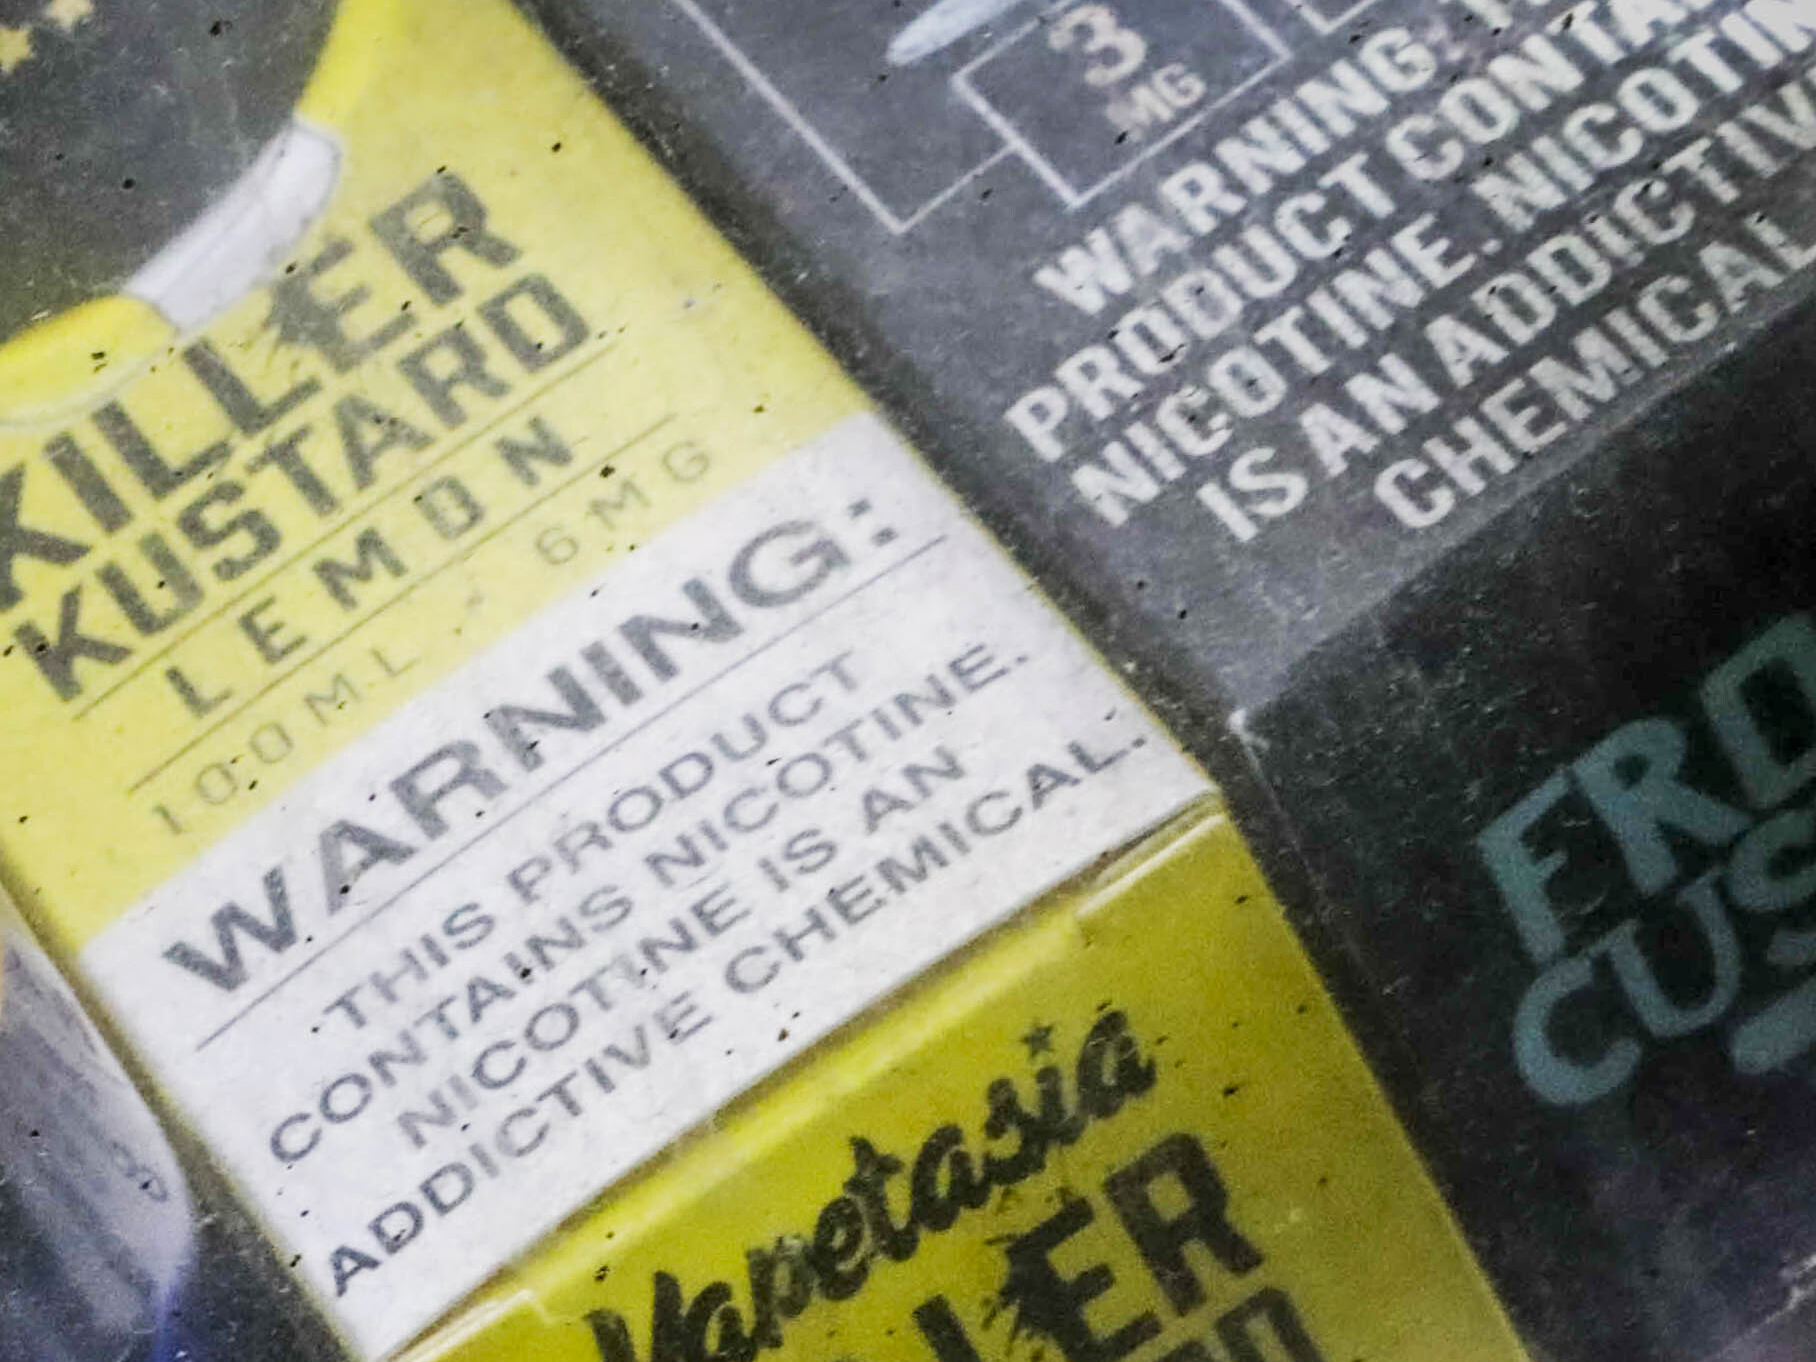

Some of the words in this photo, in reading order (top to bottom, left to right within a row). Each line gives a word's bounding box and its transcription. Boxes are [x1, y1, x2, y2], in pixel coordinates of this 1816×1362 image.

[1048, 3, 1148, 88] 3
[1104, 62, 1208, 141] MG
[1004, 148, 1397, 463] PRODUCT
[1070, 212, 1503, 530] NICOTINE.
[1197, 446, 1308, 544] IS
[1298, 351, 1436, 478] AN
[13, 273, 589, 703] KUSTARD
[164, 415, 576, 720] LEMON
[150, 640, 421, 837] 100ML
[162, 494, 899, 994] WARNING:
[324, 888, 496, 1030] THIS
[508, 650, 867, 903] PRODUCT
[269, 886, 634, 1165] CONTAINS
[646, 639, 1029, 895] NICOTINE.
[328, 987, 714, 1297] ADDICTIVE
[726, 730, 1148, 994] CHEMICAL.
[396, 886, 754, 1149] NICOTINE
[771, 825, 839, 892] IS
[857, 744, 967, 828] AN
